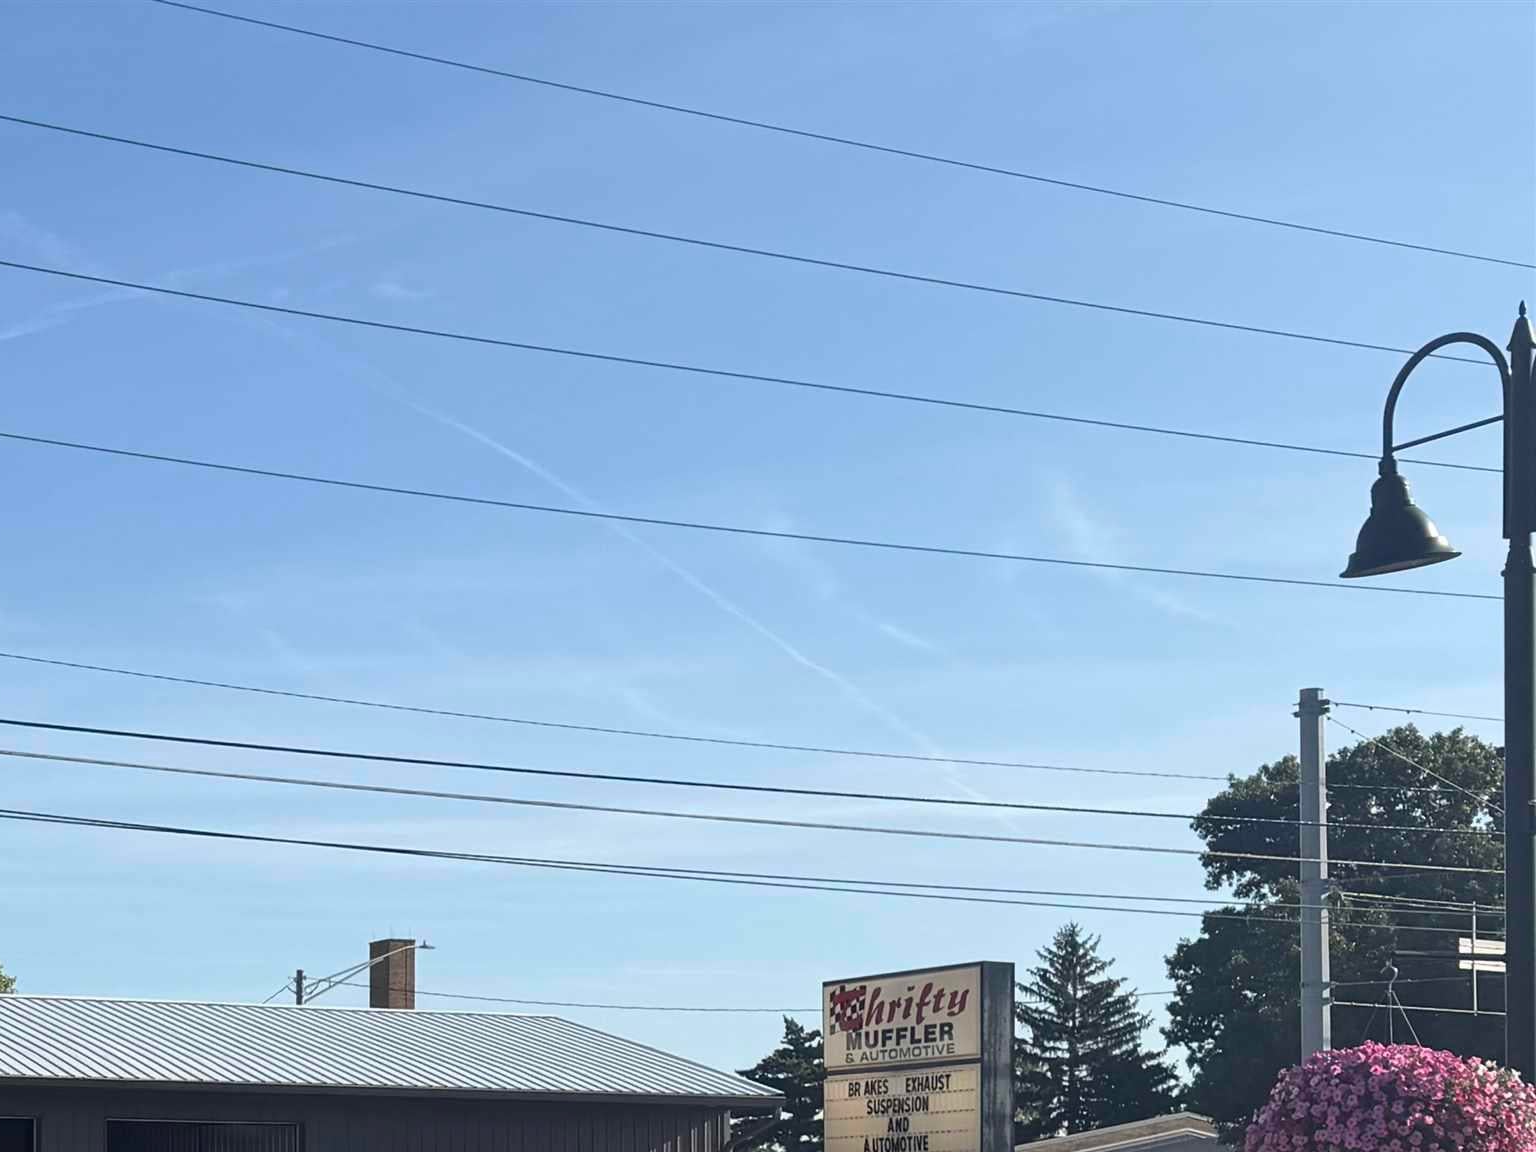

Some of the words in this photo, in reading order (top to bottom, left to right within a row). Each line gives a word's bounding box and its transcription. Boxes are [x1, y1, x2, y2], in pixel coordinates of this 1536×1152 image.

[832, 982, 970, 1032] Thrifty
[846, 1022, 954, 1051] MUFFLER
[845, 1053, 855, 1064] &
[860, 1043, 955, 1063] AUTOMOTIVE
[905, 1074, 952, 1093] EXHAUST
[867, 1095, 929, 1115] SUSPENSION
[887, 1116, 910, 1133] AND
